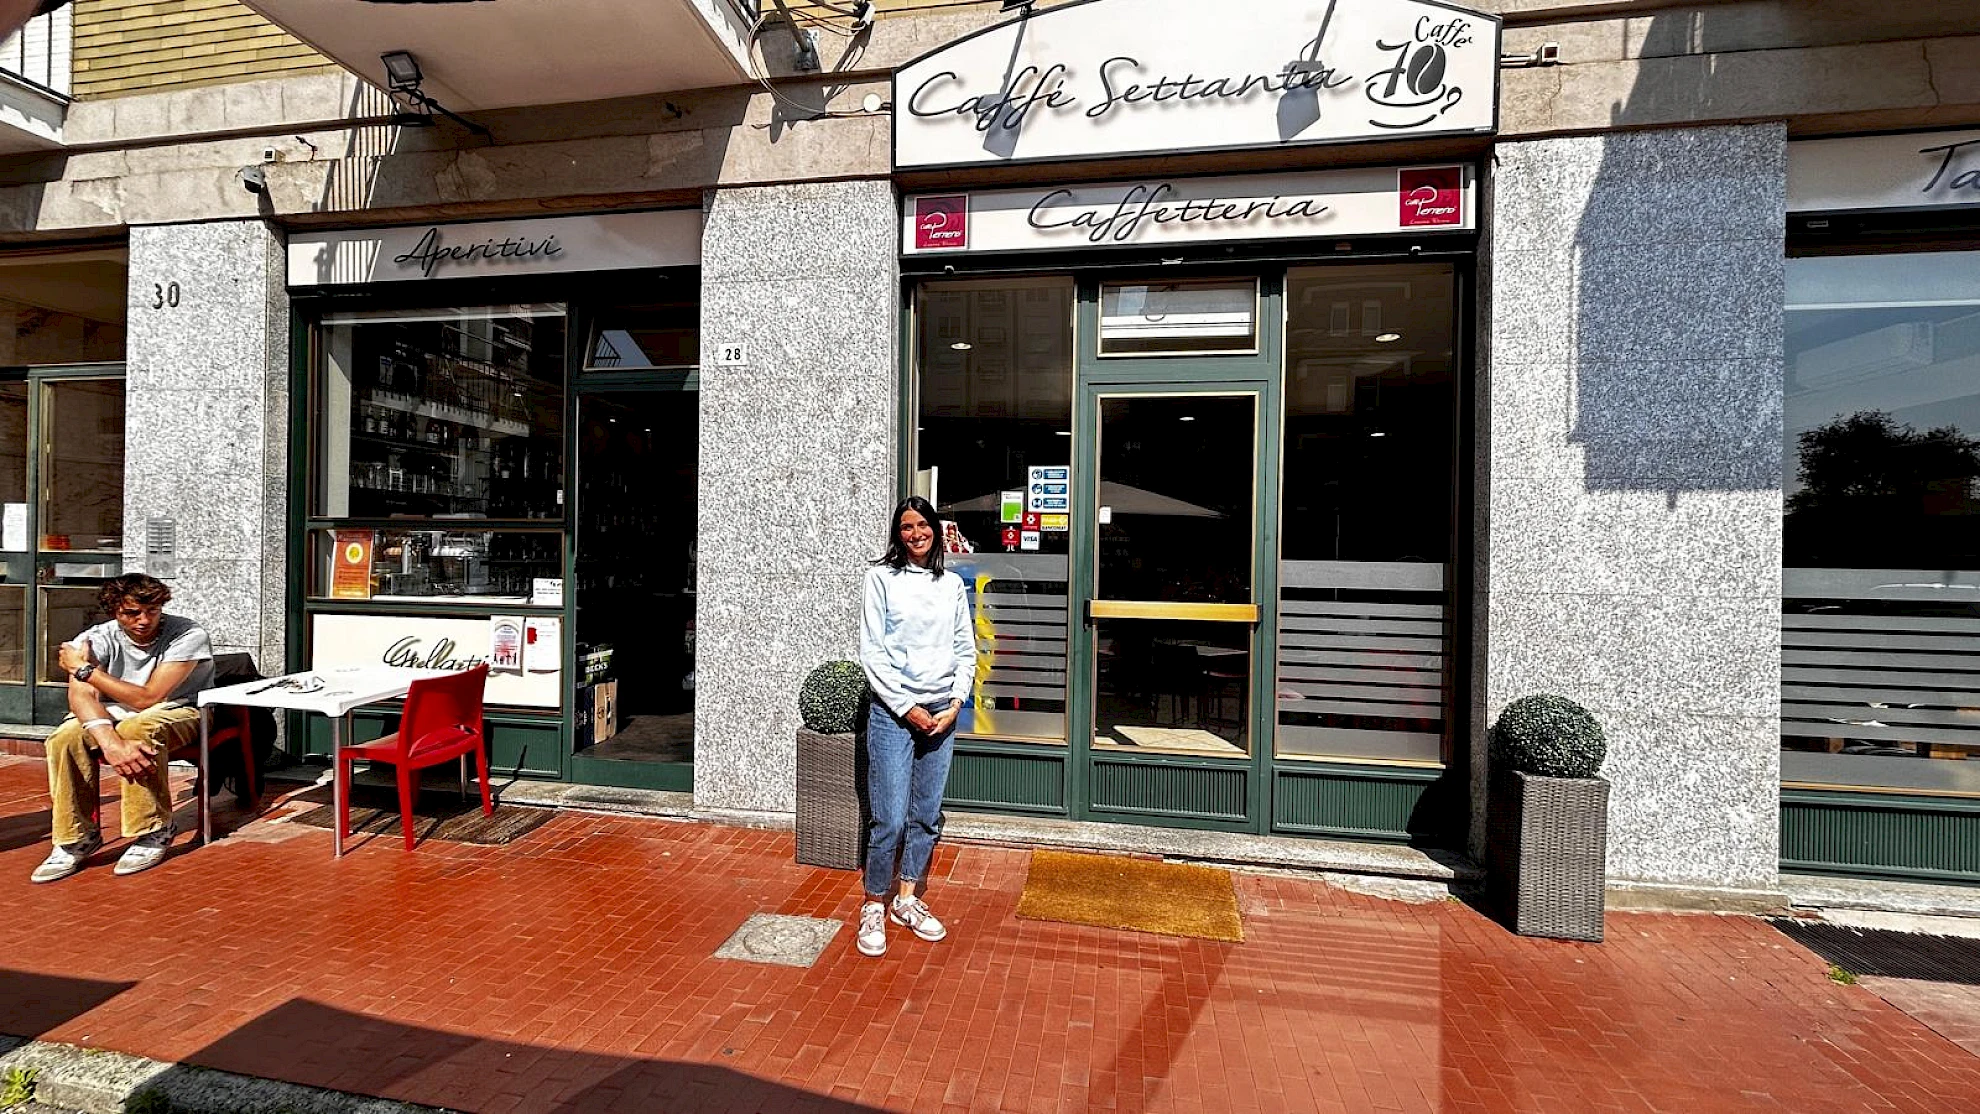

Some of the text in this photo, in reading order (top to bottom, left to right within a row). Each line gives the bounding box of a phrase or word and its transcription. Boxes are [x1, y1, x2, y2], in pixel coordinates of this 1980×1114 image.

[1086, 56, 1352, 118] Settanta
[1028, 183, 1329, 242] Caffetteria
[394, 227, 562, 278] Aperitivi
[152, 280, 180, 309] 30
[725, 348, 741, 361] 28
